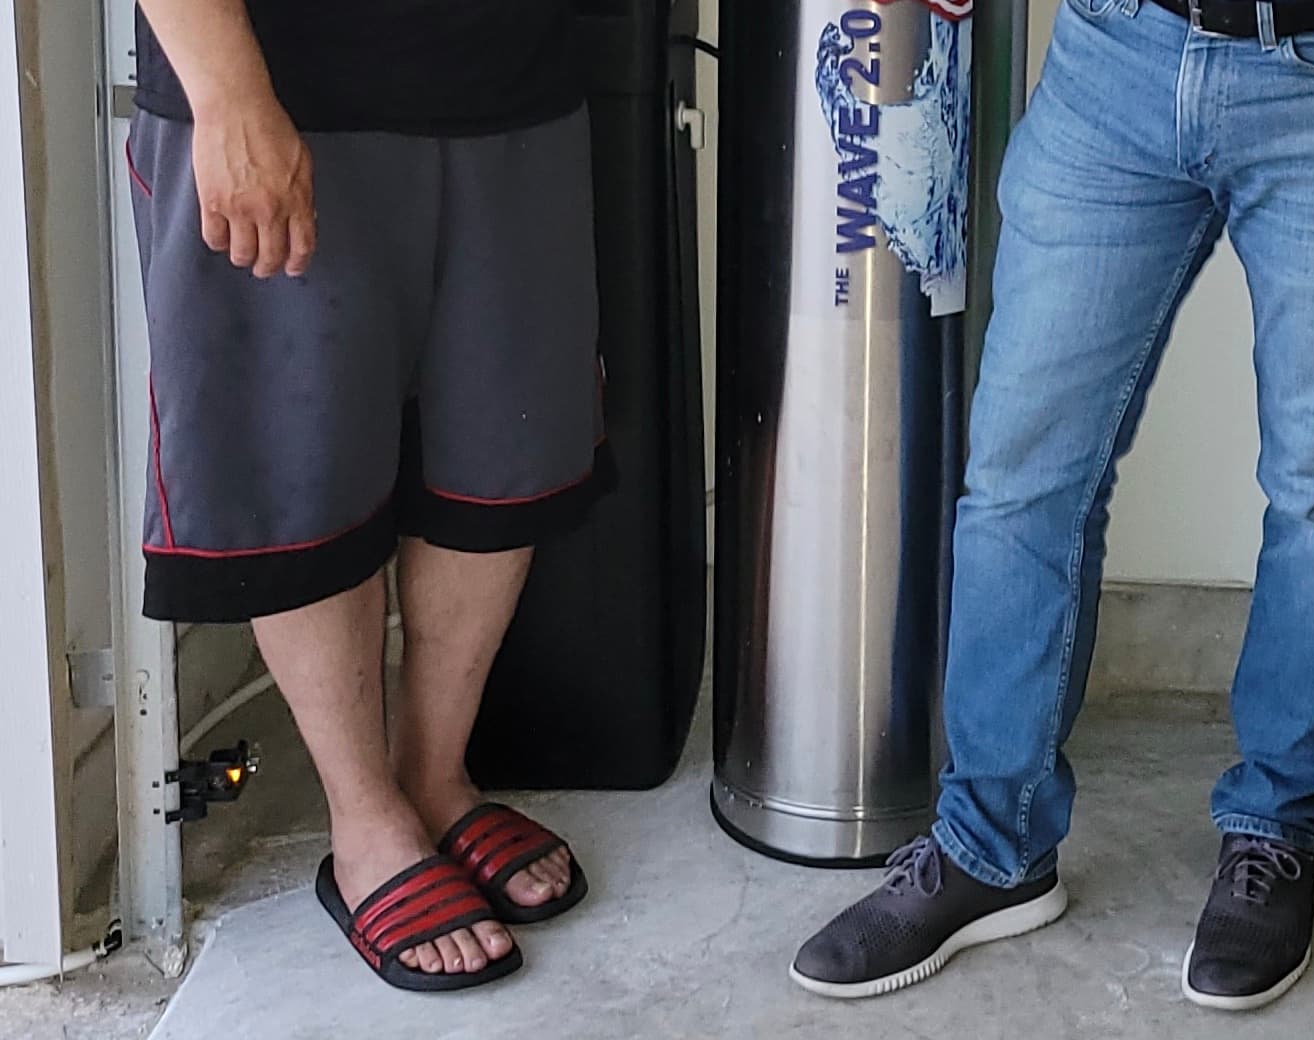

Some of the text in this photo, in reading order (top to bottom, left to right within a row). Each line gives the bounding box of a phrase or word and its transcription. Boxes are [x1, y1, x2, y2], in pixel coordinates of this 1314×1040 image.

[835, 9, 881, 306] THE WAVE 2.0
